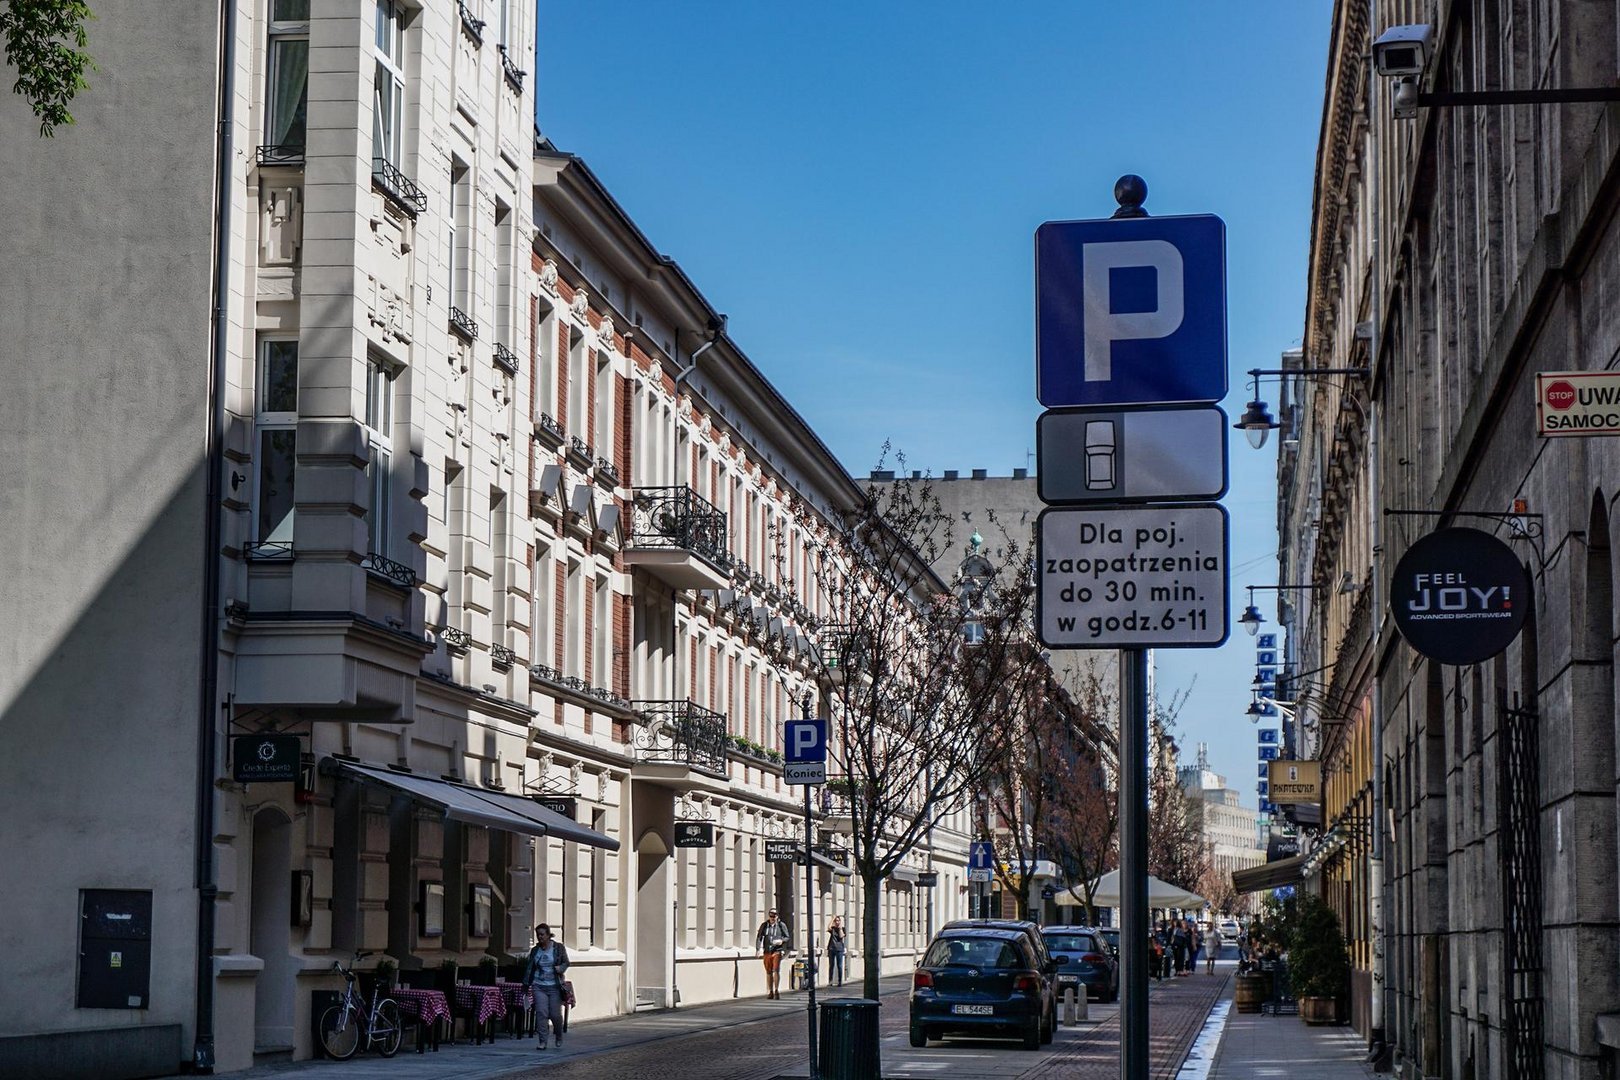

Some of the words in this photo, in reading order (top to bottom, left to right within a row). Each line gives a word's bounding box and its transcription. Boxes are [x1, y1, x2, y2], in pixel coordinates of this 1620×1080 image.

[1083, 240, 1185, 382] P
[1549, 391, 1574, 400] STOP
[1080, 523, 1122, 544] Dla
[1136, 522, 1184, 549] poj.
[1047, 550, 1218, 579] zaopatrzenia
[1060, 581, 1093, 602] do
[1105, 580, 1137, 602] 30
[1151, 580, 1204, 601] min.
[1416, 573, 1467, 591] FEEL
[1409, 586, 1512, 611] JOY!
[1058, 617, 1076, 632] w
[794, 724, 818, 757] P
[786, 768, 822, 778] Koniec
